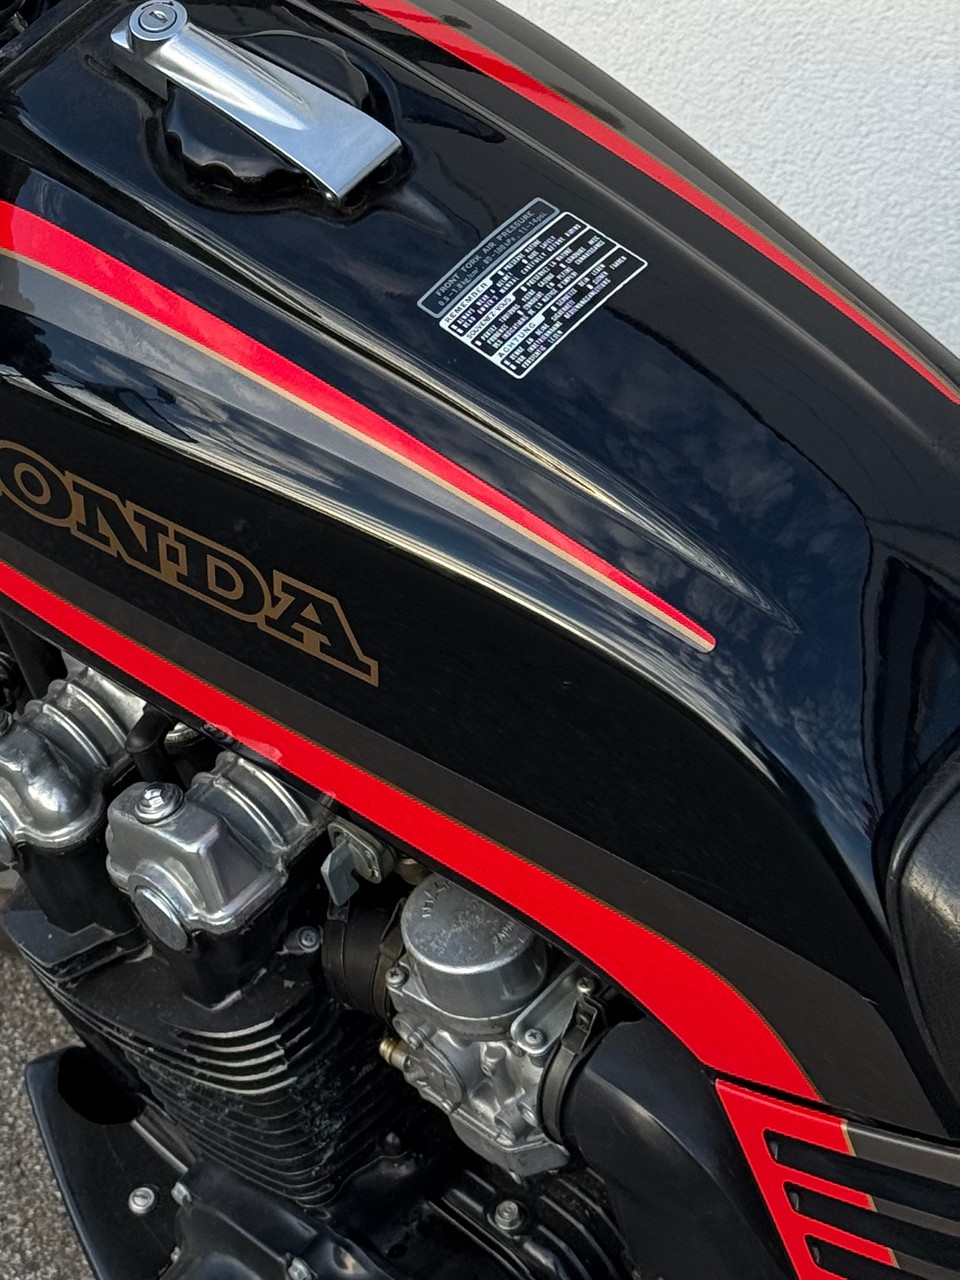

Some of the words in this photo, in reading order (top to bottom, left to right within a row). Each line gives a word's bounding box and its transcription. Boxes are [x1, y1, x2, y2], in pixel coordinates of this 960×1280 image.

[435, 273, 460, 296] FRONT
[460, 254, 482, 272] FORK
[481, 241, 496, 253] AIR
[496, 210, 535, 241] PRESSURE
[444, 282, 488, 323] REMEMBER
[497, 321, 536, 357] ACHTUNG
